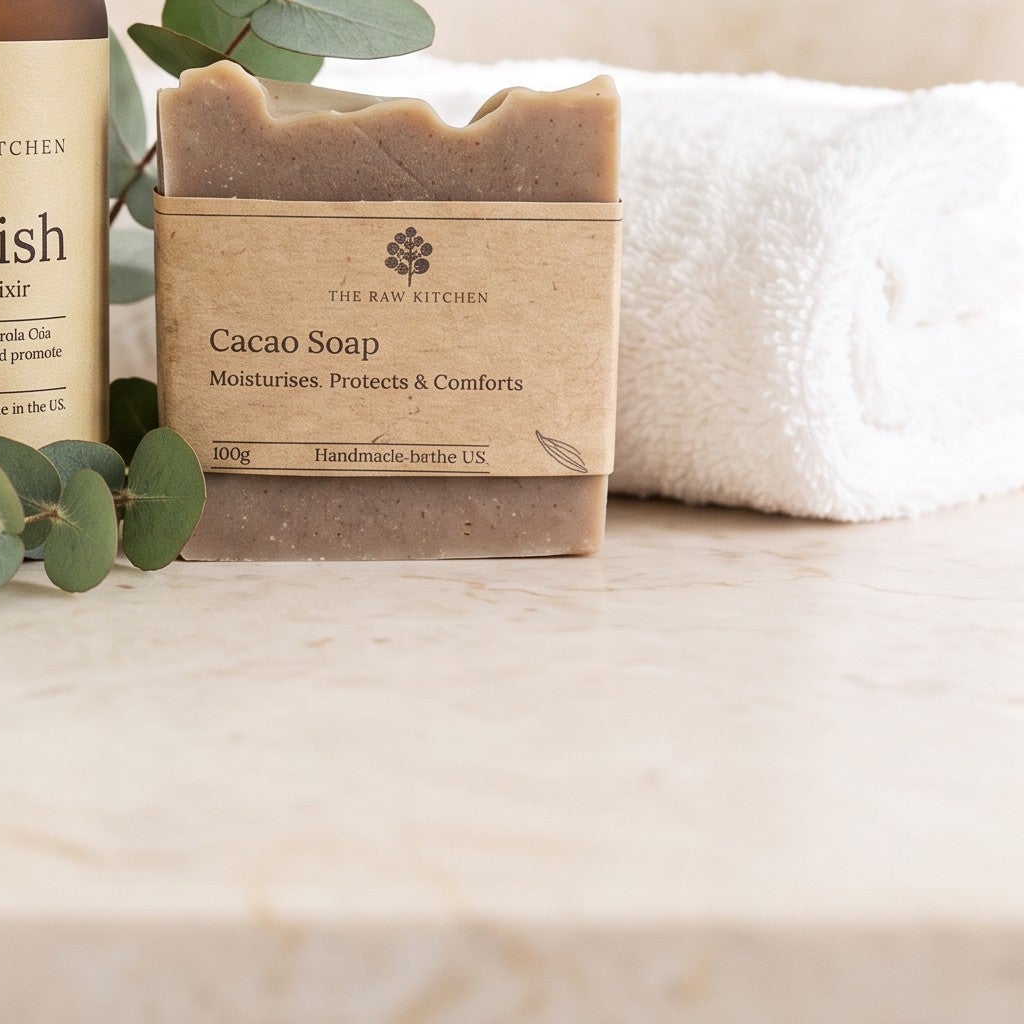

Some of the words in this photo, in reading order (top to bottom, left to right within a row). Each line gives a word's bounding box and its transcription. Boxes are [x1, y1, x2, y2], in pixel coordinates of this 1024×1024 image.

[328, 290, 361, 302] THE
[369, 291, 405, 303] RAW
[413, 291, 489, 304] KITCHEN
[209, 328, 299, 354] Cacao
[308, 330, 380, 361] Soap
[10, 346, 63, 364] promote
[329, 373, 409, 390] Protects
[414, 374, 429, 390] &
[433, 374, 523, 392] Comforts
[12, 402, 24, 415] in
[27, 401, 46, 413] the
[212, 446, 251, 464] 100g
